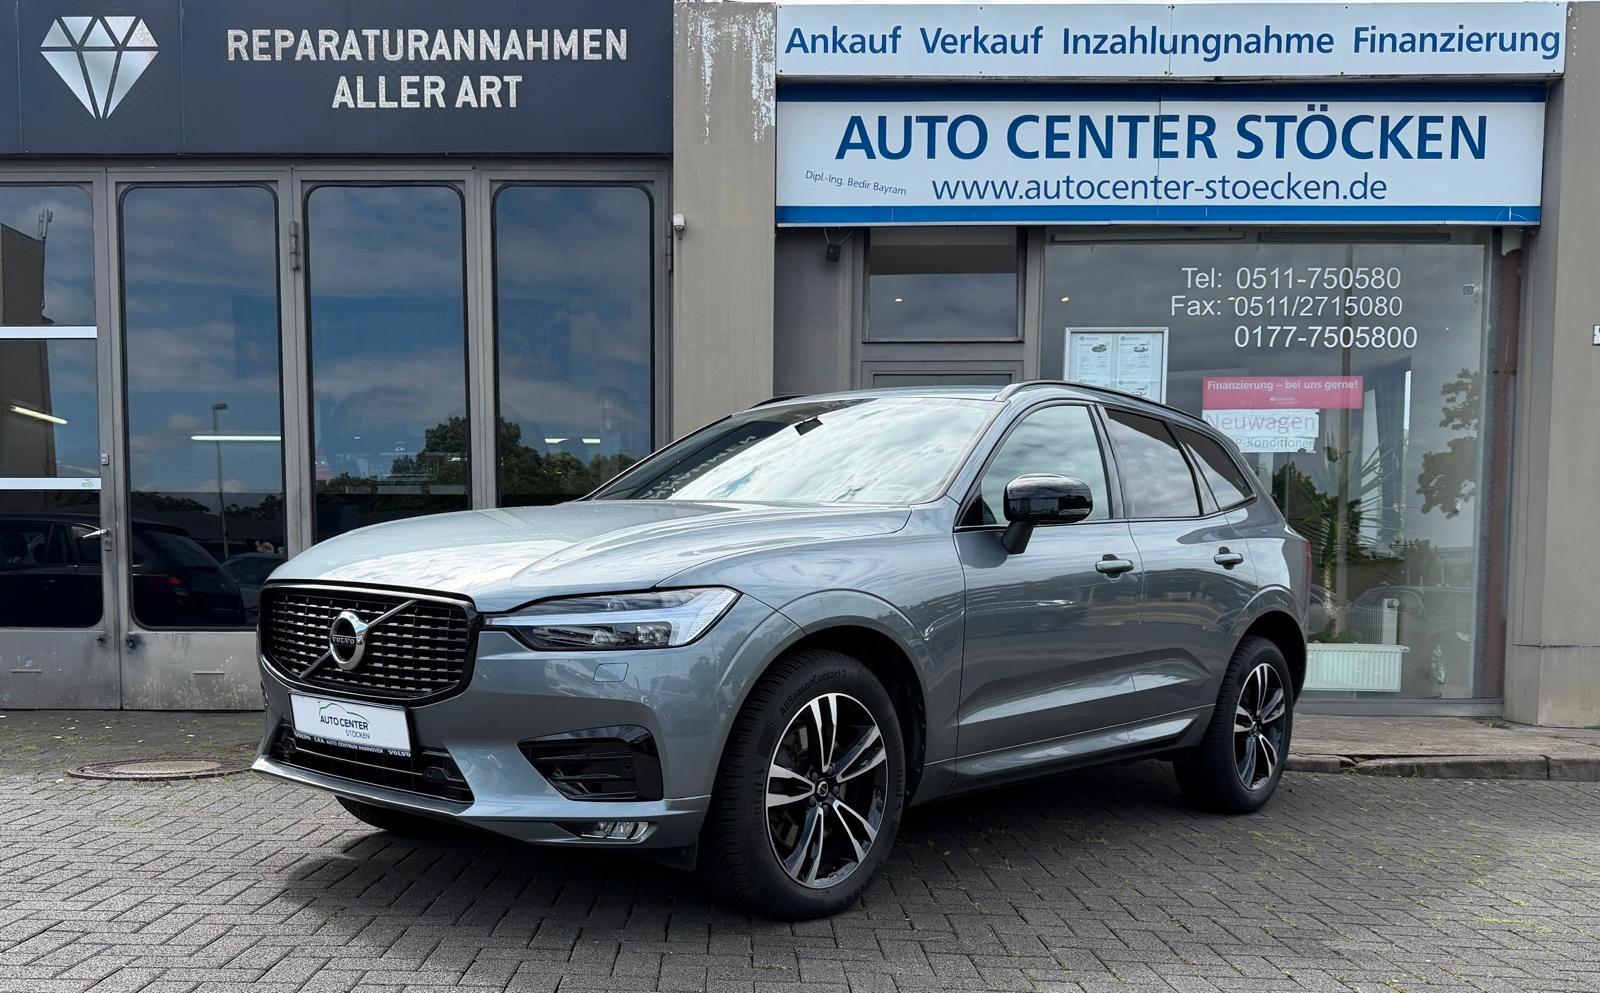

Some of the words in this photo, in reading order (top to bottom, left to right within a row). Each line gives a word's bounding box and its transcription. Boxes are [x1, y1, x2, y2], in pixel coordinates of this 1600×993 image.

[227, 28, 628, 61] REPARATURANNAHMEN
[785, 25, 902, 54] Ankauf
[920, 25, 1044, 55] Verkauf
[1063, 25, 1335, 63] Inzahlungnahme
[1353, 24, 1561, 60] Finanzierung
[331, 75, 446, 109] ALLER
[455, 75, 523, 109] ART
[835, 114, 989, 160] AUTO
[1006, 114, 1218, 160] CENTER
[1236, 103, 1488, 160] STÖCKEN
[805, 170, 845, 187] Dipl.-Ing.
[847, 177, 871, 189] Bedir
[873, 182, 907, 195] Bayram
[931, 172, 1388, 200] www.autocenter-stoecken.de
[1182, 267, 1222, 289] Tel:
[1235, 267, 1401, 290] 0511-750580
[1170, 295, 1222, 317] Fax:
[1234, 295, 1403, 317] 0511/2715080
[1234, 325, 1418, 349] 0177-7505800
[1207, 380, 1274, 392] Finanzierung
[1285, 379, 1301, 390] bei
[1304, 381, 1322, 390] uns
[1324, 379, 1358, 391] gerne!
[1205, 413, 1316, 434] Neuwagen
[332, 636, 355, 645] VOLVO
[320, 715, 340, 726] AUTO
[340, 718, 369, 730] CENTER
[388, 749, 411, 758] VOLVO
